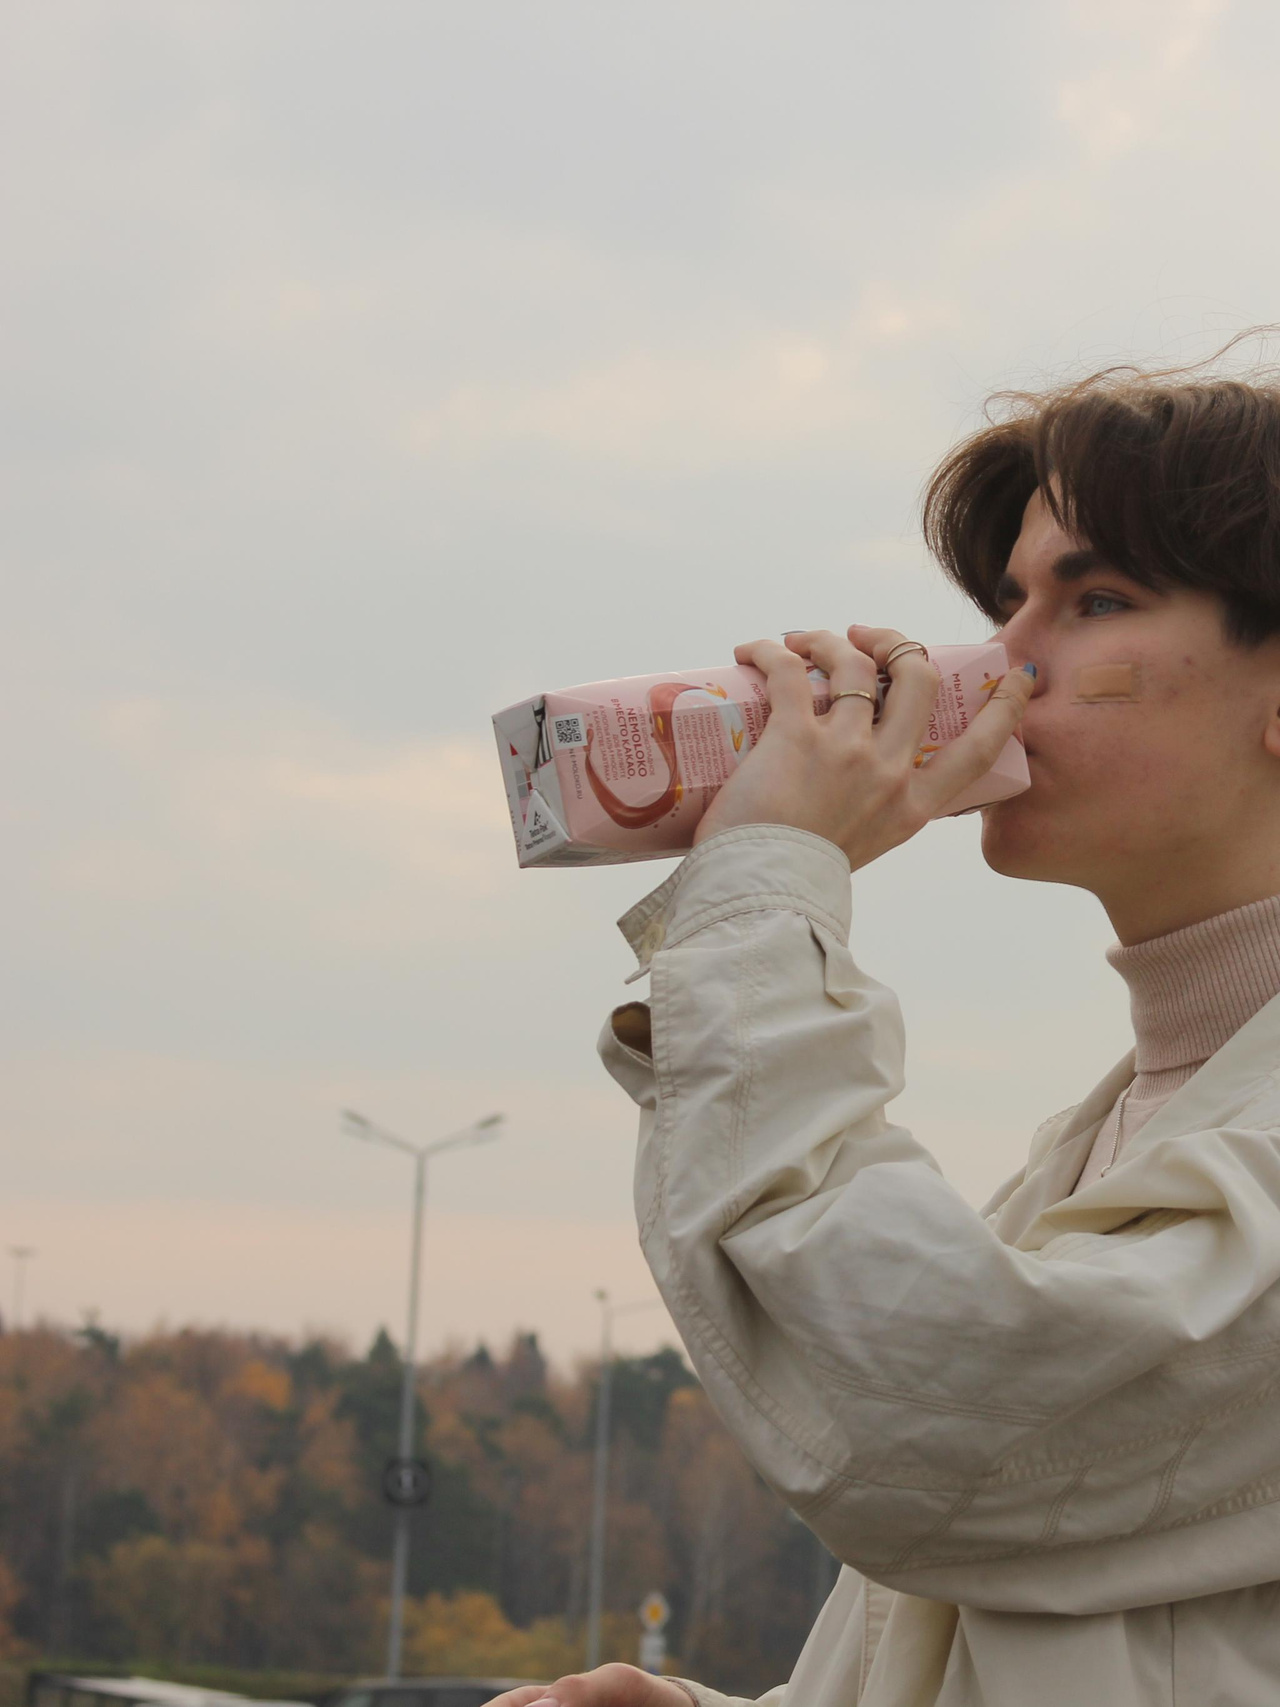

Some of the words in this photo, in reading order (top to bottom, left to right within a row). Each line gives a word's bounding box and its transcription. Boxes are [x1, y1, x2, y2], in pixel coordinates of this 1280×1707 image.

[952, 673, 962, 692] МЫ
[955, 694, 965, 709] ЗА
[611, 698, 628, 737] ВМЕСТО
[750, 683, 770, 729] ПОЛЕЗНЫ
[627, 708, 648, 777] NEMOLOKO
